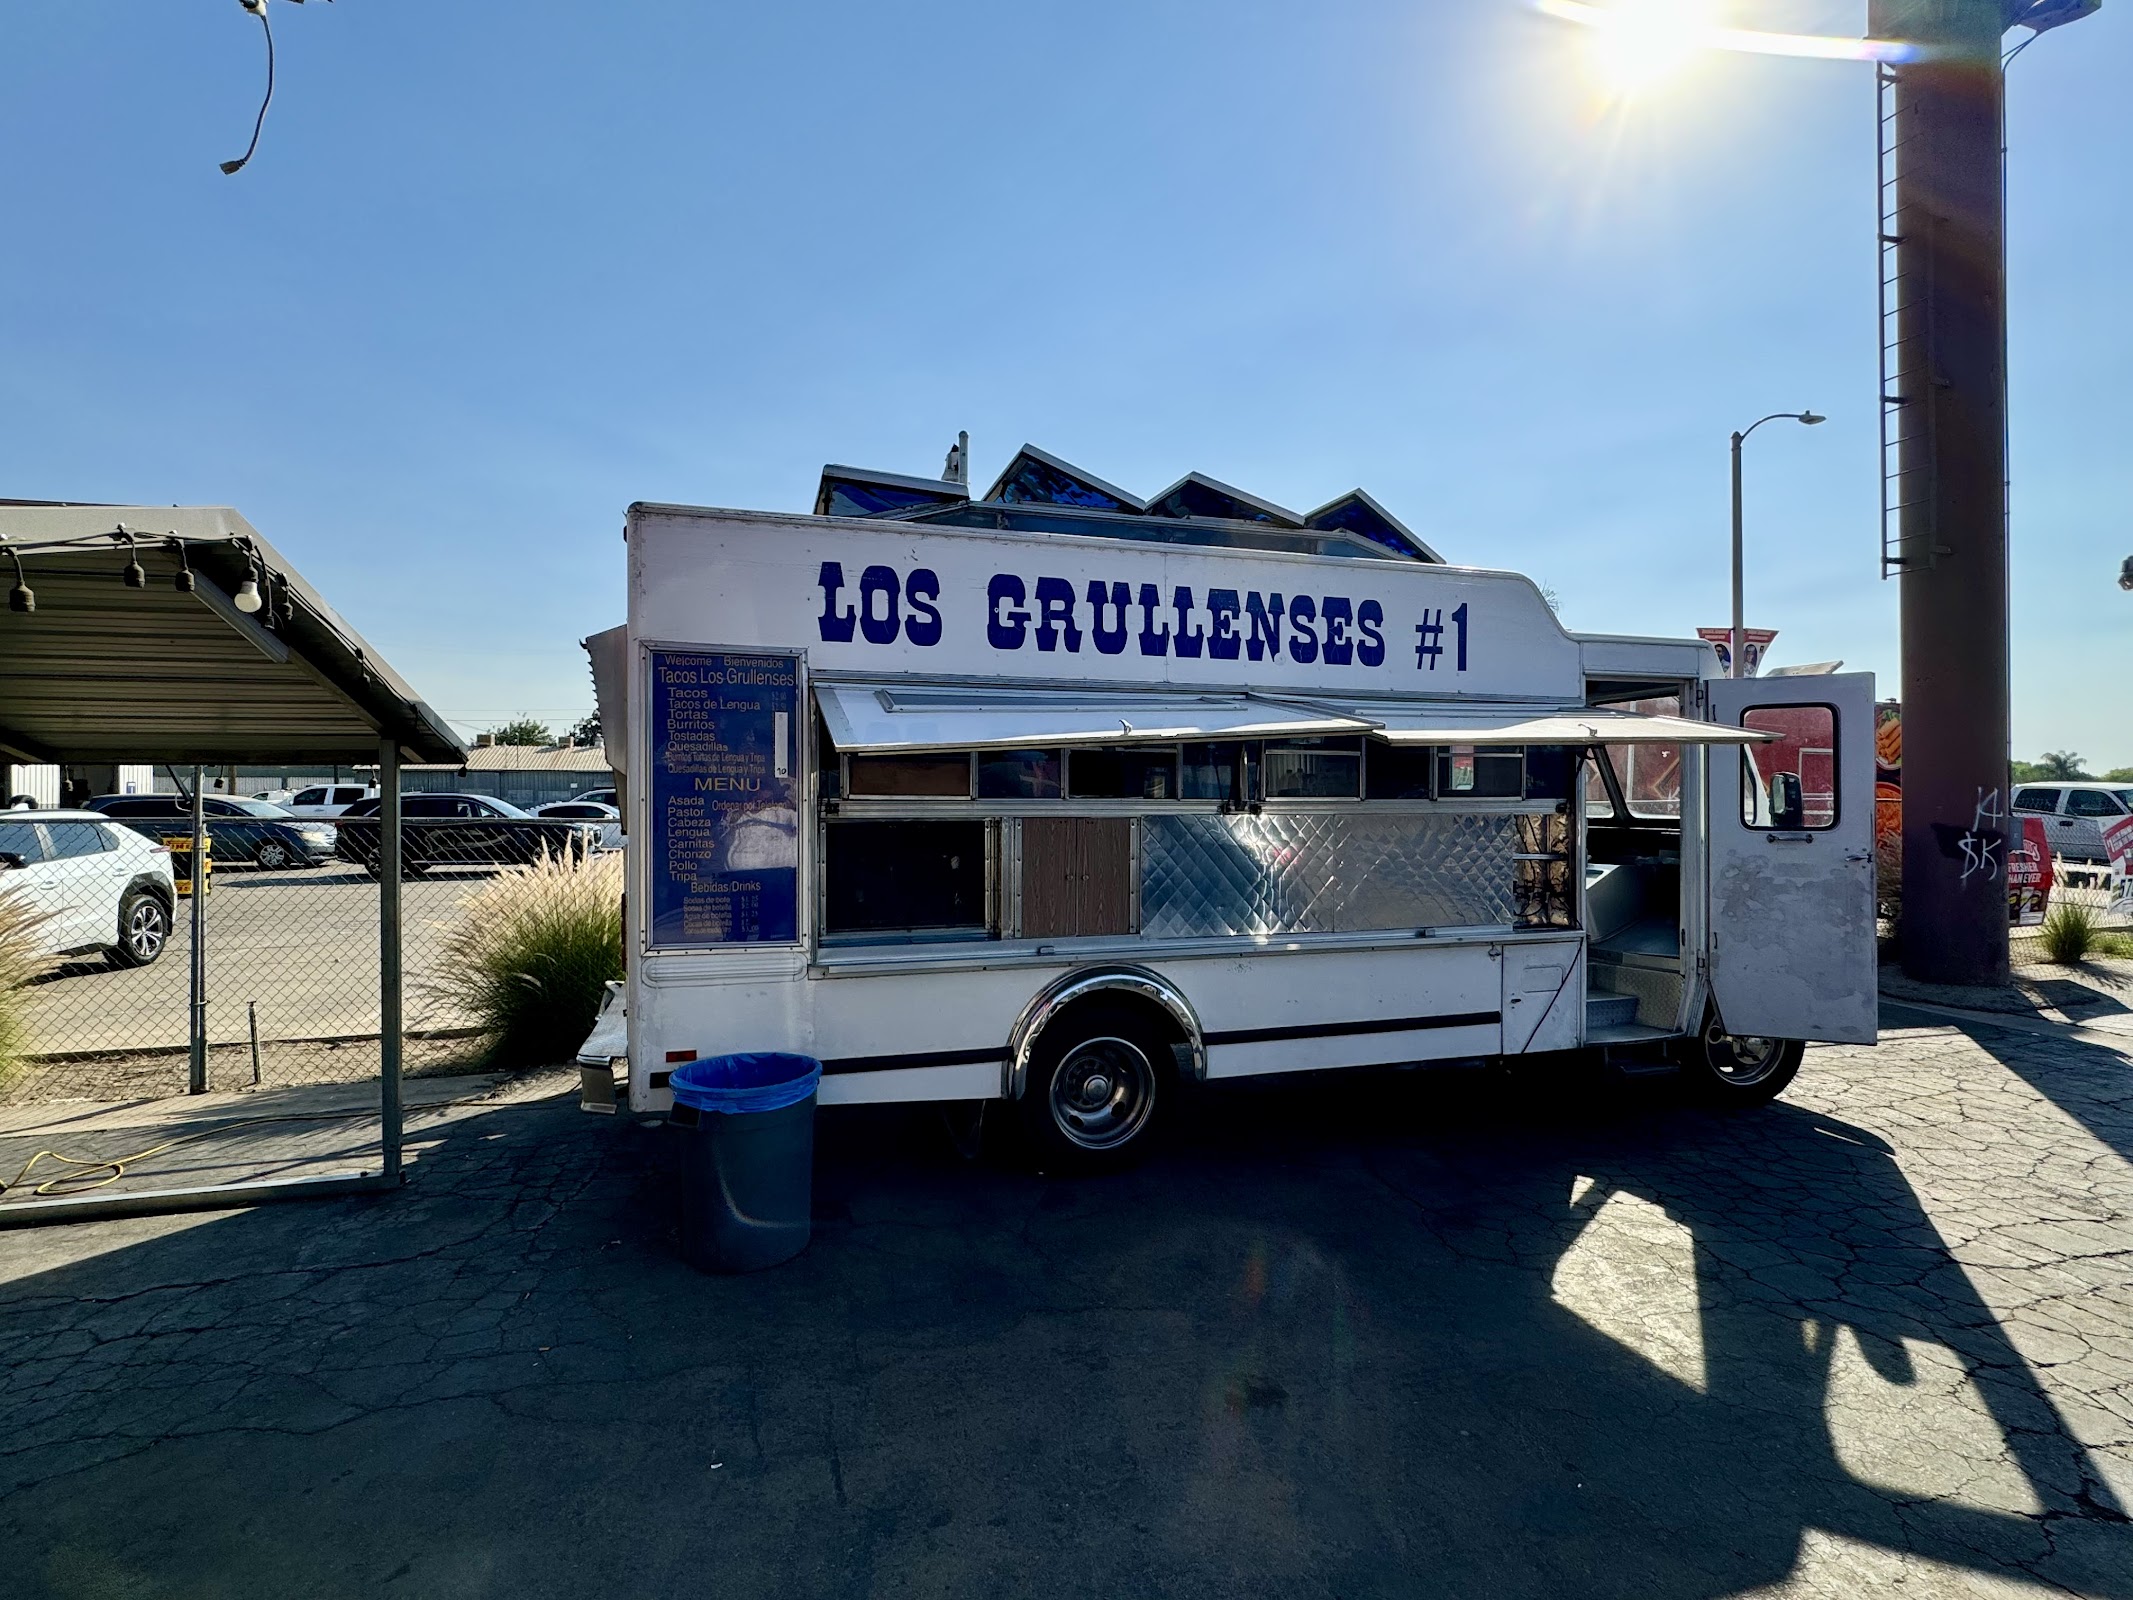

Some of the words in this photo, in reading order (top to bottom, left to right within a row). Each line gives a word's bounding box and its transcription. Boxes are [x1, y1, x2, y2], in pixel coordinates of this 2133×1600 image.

[817, 561, 943, 647] LOS
[987, 574, 1386, 667] GRULLENSES
[1415, 602, 1469, 672] #1
[665, 655, 712, 666] Welcome
[724, 656, 784, 668] Bienvenidos
[658, 667, 697, 684] Tacos
[700, 668, 724, 684] Los
[726, 668, 795, 686] Grullenses
[667, 687, 708, 698] Tacos
[668, 699, 700, 709] Tacos
[703, 699, 717, 709] de
[720, 697, 761, 712] Lengua
[668, 709, 708, 719] Tortas
[667, 719, 715, 729] Burritos
[668, 730, 715, 741] Tostadas
[668, 741, 728, 751] Quesadillas
[695, 778, 760, 791] MENU
[668, 796, 704, 806] Asada
[668, 807, 704, 817] Pastor
[668, 817, 711, 827] Cabeza
[668, 828, 710, 839] Lengua
[668, 839, 715, 849] Carnitas
[669, 861, 697, 870] Pollo
[669, 871, 697, 882] Tripa
[2023, 873, 2041, 883] EVER
